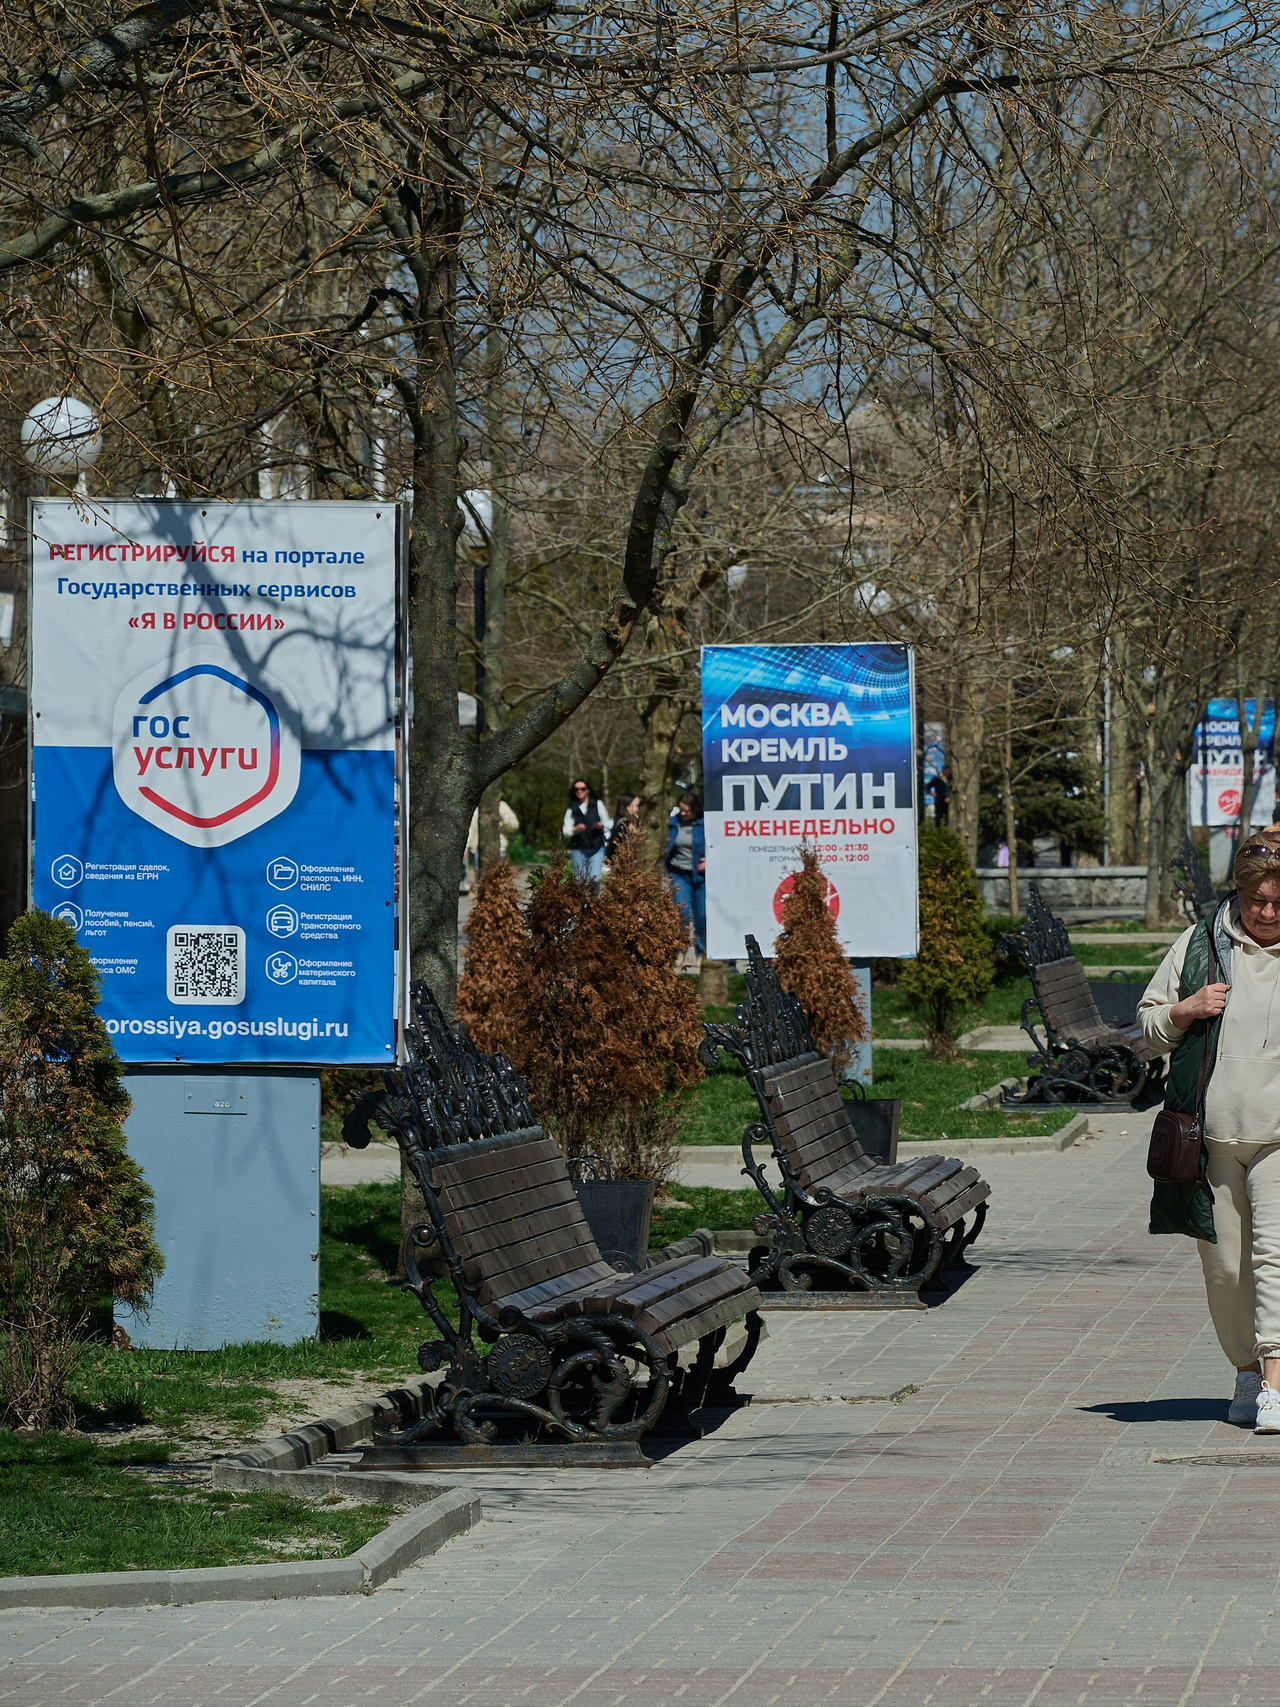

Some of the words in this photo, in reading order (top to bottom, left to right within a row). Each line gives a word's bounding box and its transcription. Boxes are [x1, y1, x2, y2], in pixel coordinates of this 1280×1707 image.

[50, 541, 235, 563] РЕГИСТРИРУЙСЯ
[242, 550, 268, 563] на
[275, 550, 365, 568] портале
[58, 577, 251, 599] Государственных
[257, 584, 356, 601] сервисов
[128, 612, 156, 630] «Я
[163, 613, 176, 630] В
[183, 612, 285, 631] РОССИИ»
[721, 702, 853, 728] МОСКВА
[721, 737, 849, 762] КРЕМЛЬ
[722, 772, 896, 812] ПУТИН
[723, 817, 896, 840] ЕЖЕНЕДЕЛЬНО
[844, 843, 869, 852] 21:30
[845, 853, 870, 862] 12:00
[85, 862, 137, 872] Регистрация
[138, 864, 170, 872] сделок,
[300, 864, 355, 874] Оформление
[85, 872, 124, 881] сведения
[136, 872, 159, 880] ЕГРН
[300, 873, 341, 884] паспорта,
[342, 874, 364, 883] ИНН,
[300, 883, 332, 891] СНИЛС
[85, 909, 129, 919] Получение
[300, 912, 353, 922] Регистрация
[85, 919, 122, 928] пособий,
[123, 920, 155, 928] пенсий,
[300, 922, 362, 932] транспортного
[85, 929, 107, 937] льгот
[300, 931, 339, 941] средства
[298, 959, 353, 969] Оформление
[115, 966, 136, 975] ОМС
[298, 969, 356, 979] материнского
[103, 1016, 349, 1041] orossiya.gosuslugi.ru
